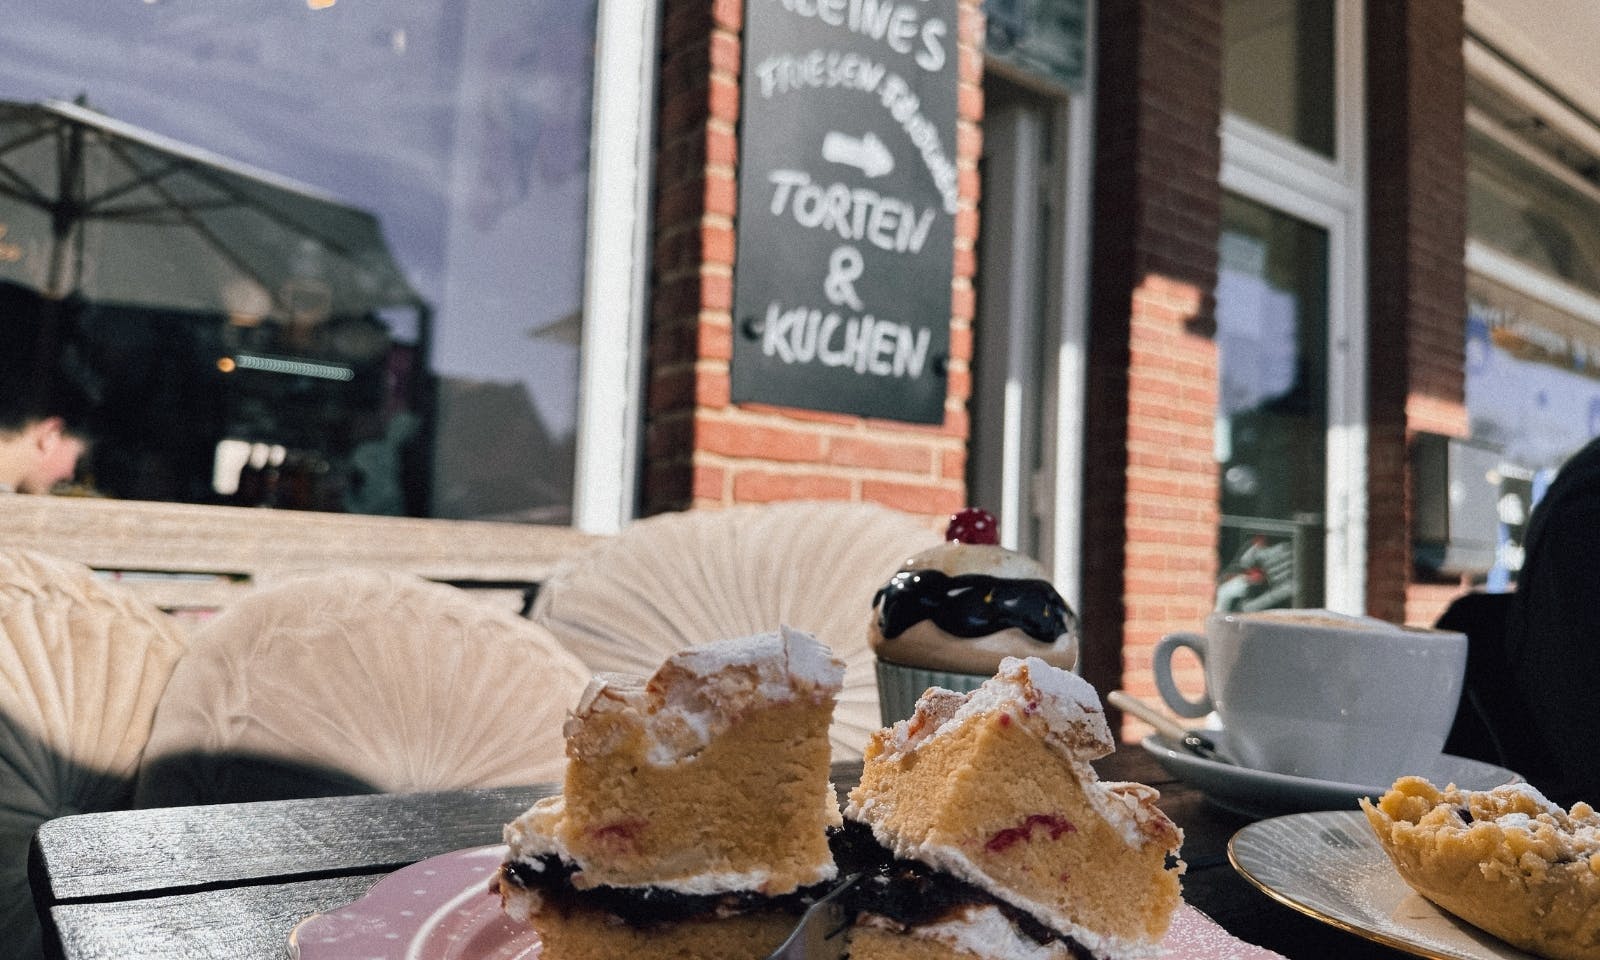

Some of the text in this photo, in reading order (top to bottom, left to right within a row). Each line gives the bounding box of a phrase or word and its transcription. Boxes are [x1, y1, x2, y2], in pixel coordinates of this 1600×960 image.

[768, 169, 936, 254] TORTEN
[824, 245, 865, 312] &
[762, 303, 931, 378] KUCHEN
